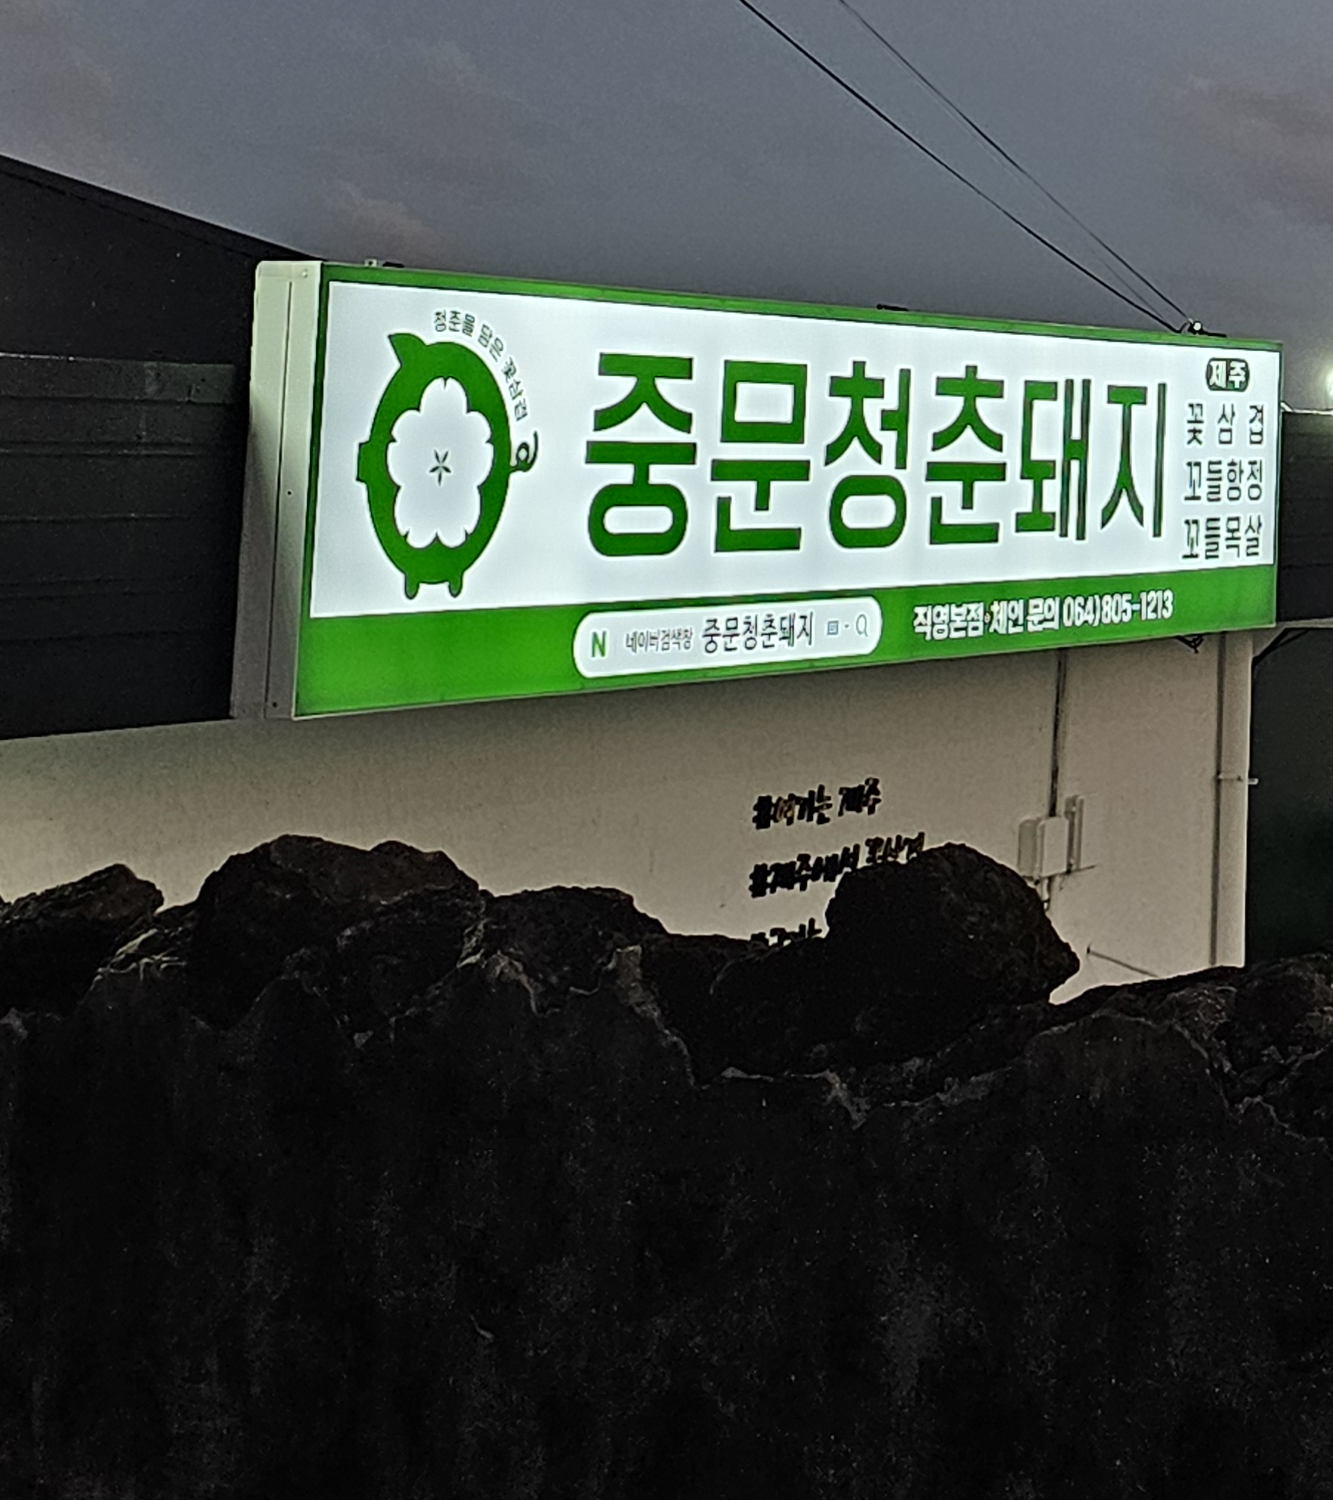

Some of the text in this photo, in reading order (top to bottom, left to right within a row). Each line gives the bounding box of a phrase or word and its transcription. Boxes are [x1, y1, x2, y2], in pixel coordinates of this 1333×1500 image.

[478, 324, 504, 362] 담은
[1208, 359, 1247, 390] 제주
[584, 352, 1167, 558] 중문청춘돼지
[1184, 458, 1263, 503] 꼬들항정
[1182, 514, 1263, 560] 꼬들목살
[702, 611, 814, 654] 중문청춘돼지
[1026, 595, 1060, 633] 문의
[591, 630, 607, 657] N
